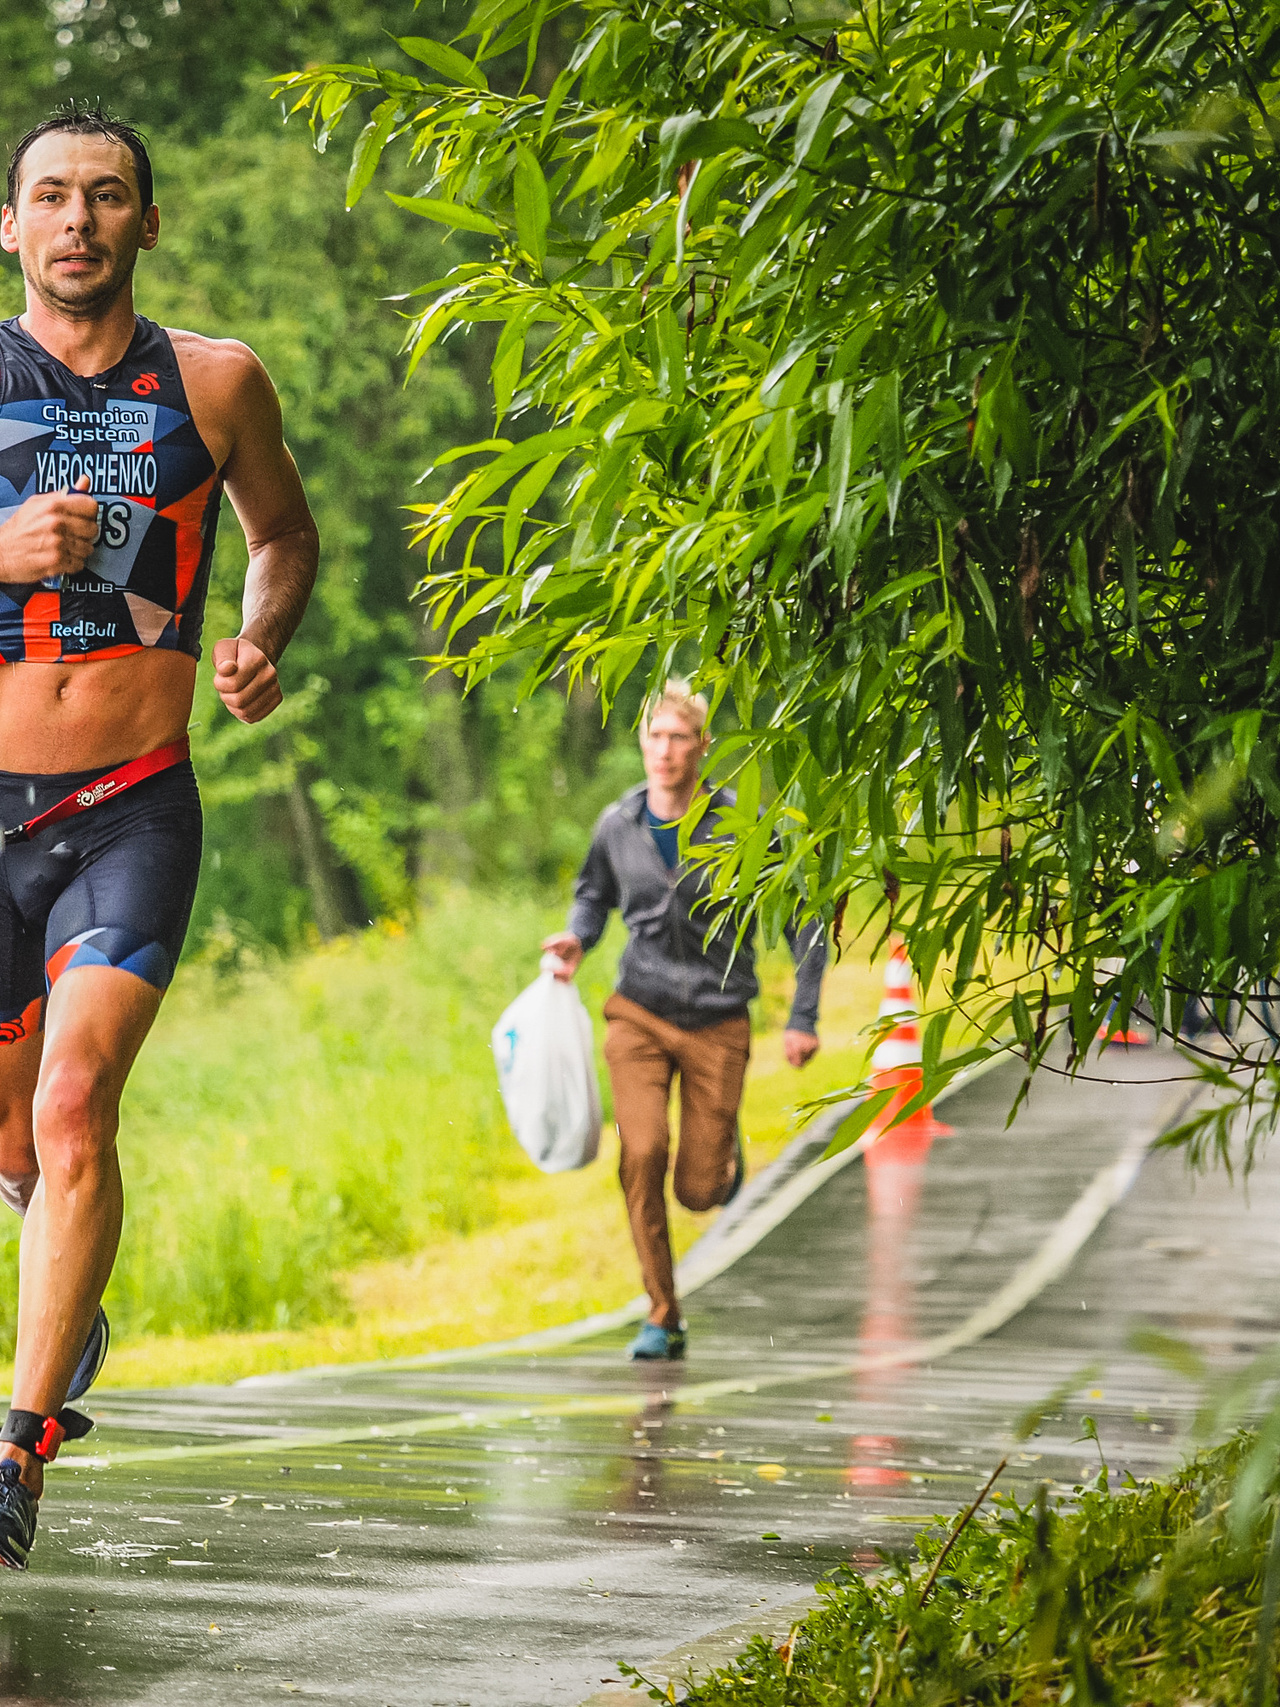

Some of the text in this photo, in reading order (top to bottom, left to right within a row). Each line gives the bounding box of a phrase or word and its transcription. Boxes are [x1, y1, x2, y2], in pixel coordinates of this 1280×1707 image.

[42, 405, 148, 427] Champion
[55, 424, 138, 444] System
[36, 452, 157, 495] YAROSHENKO
